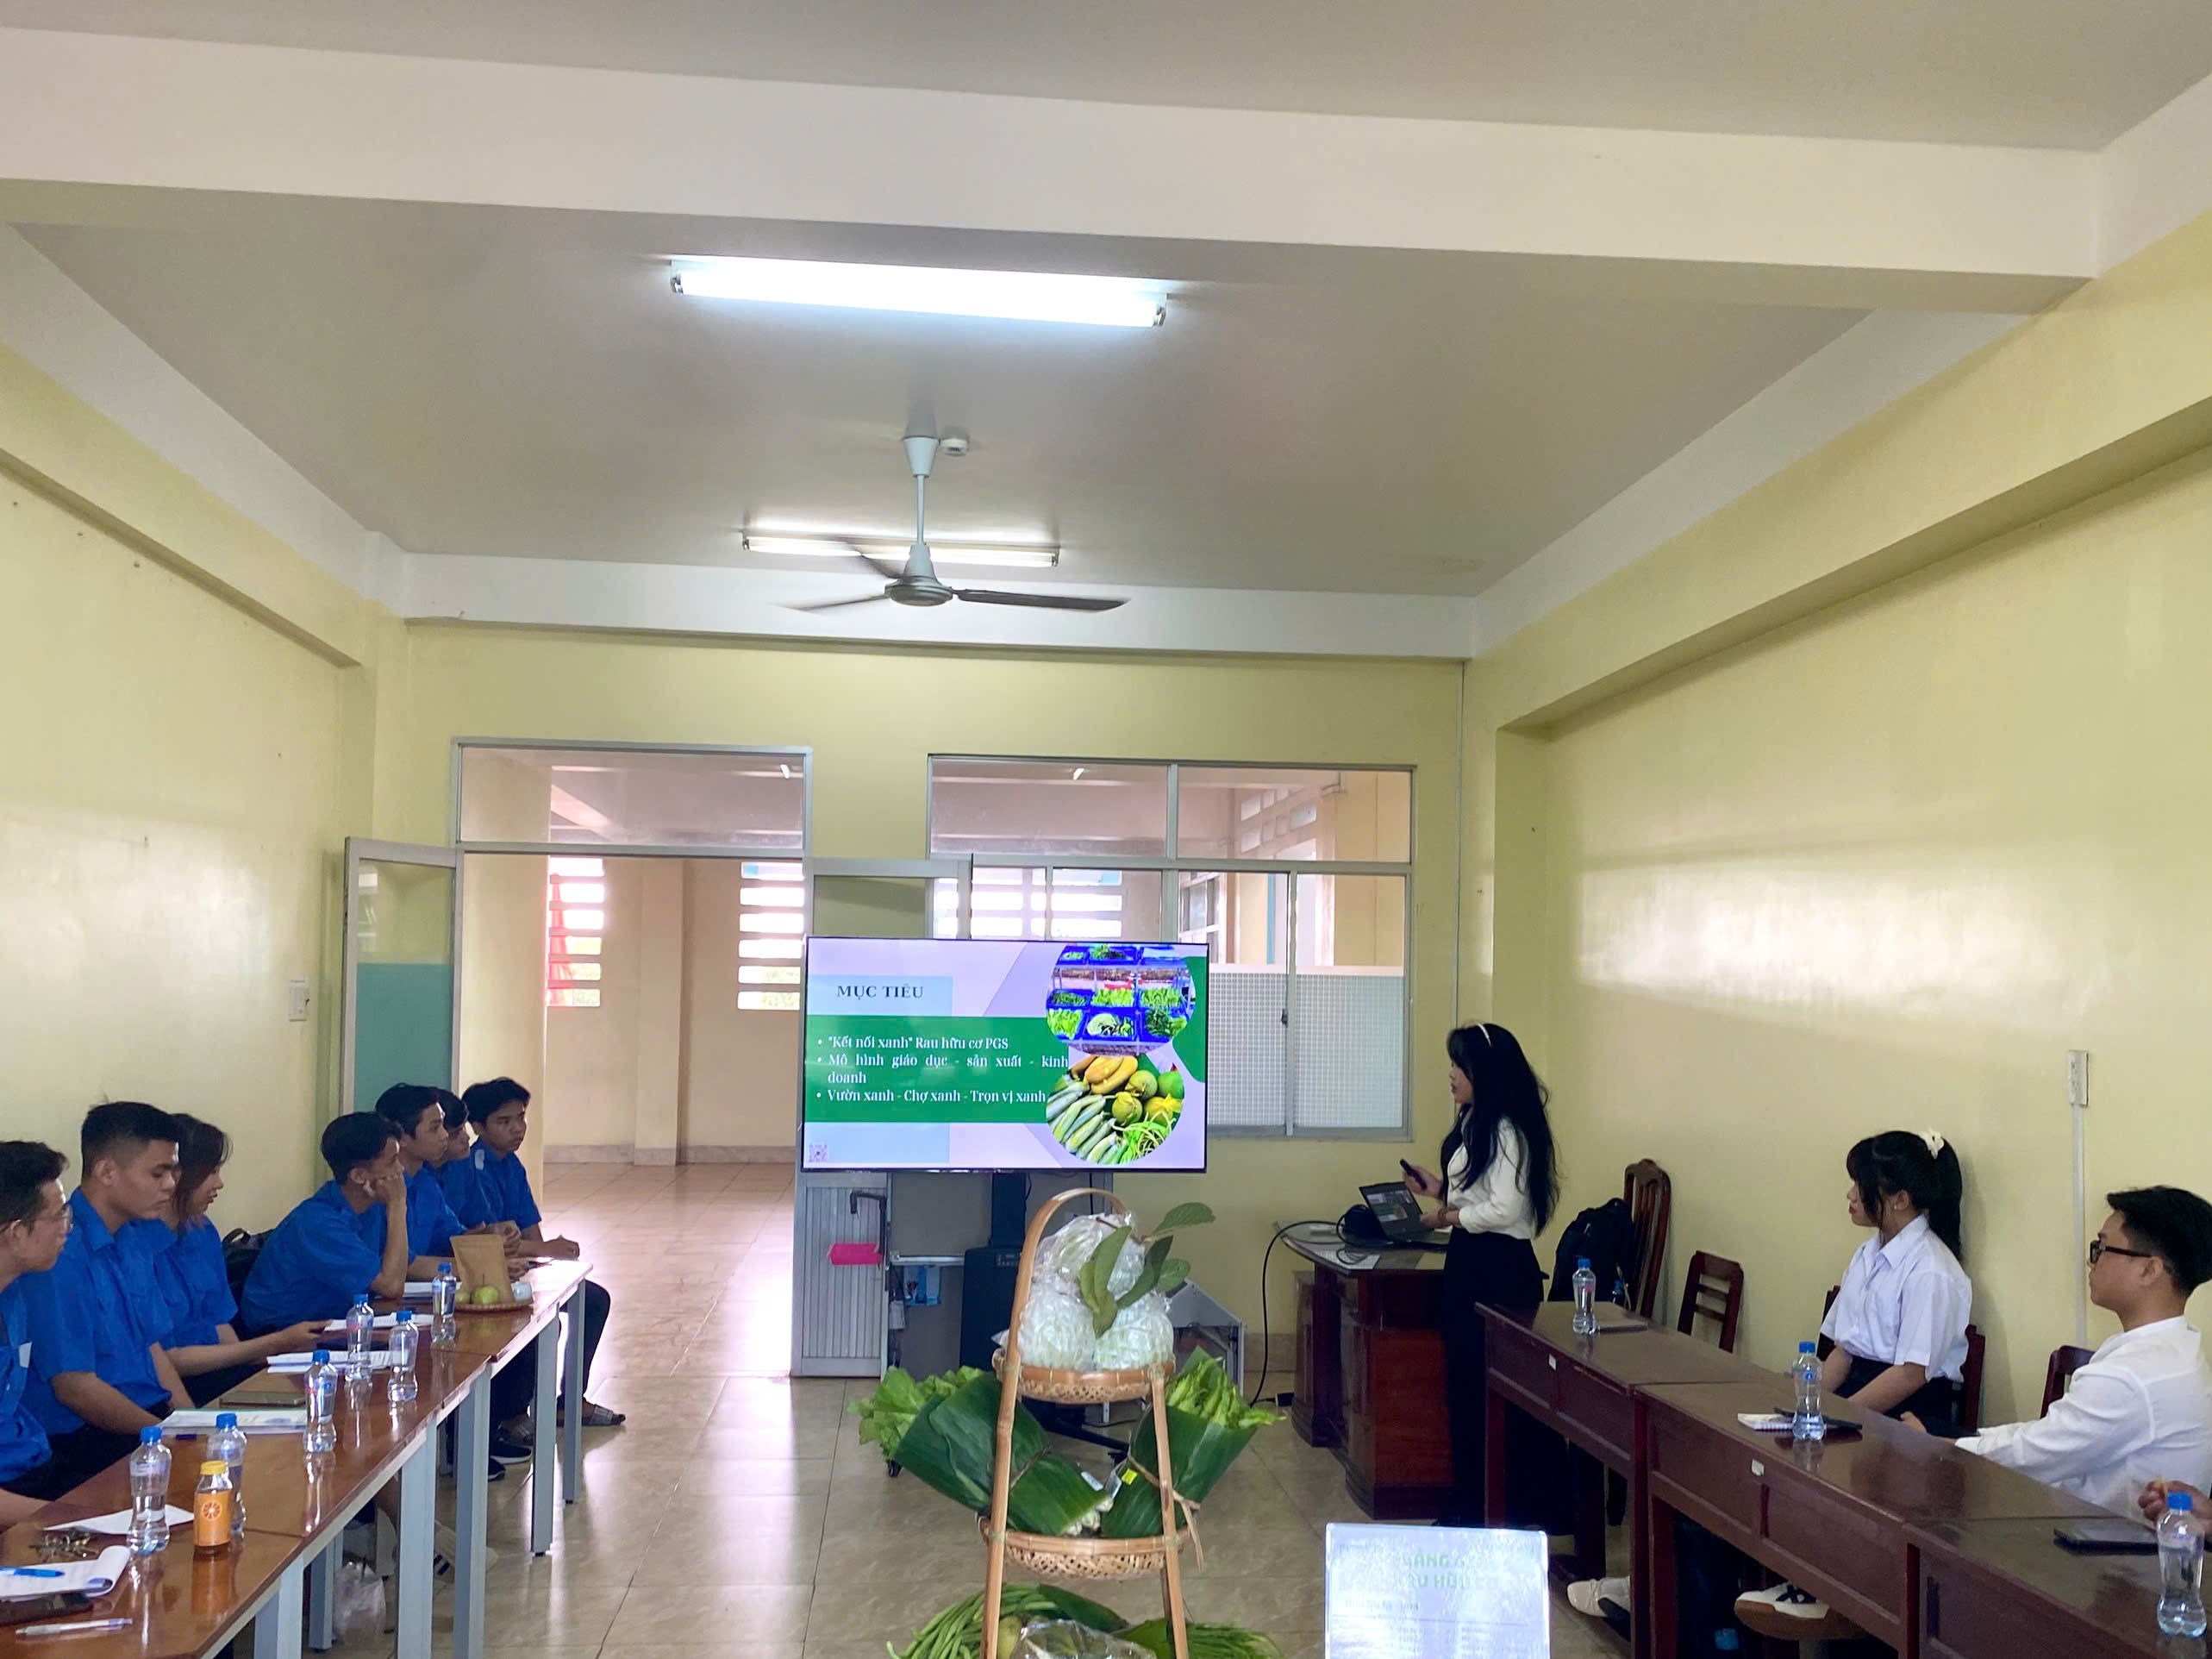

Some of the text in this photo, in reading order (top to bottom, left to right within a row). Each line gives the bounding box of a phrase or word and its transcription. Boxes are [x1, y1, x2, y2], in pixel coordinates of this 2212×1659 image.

[837, 983, 924, 1000] MỤC TIÊU
[855, 1036, 875, 1049] nối
[915, 1037, 938, 1049] Rau
[941, 1036, 965, 1049] hữu
[968, 1039, 983, 1049] cơ
[985, 1038, 1009, 1049] PGS
[828, 1054, 848, 1066] Mô
[855, 1054, 884, 1066] hình
[891, 1054, 918, 1069] giáo
[925, 1055, 948, 1068] dục
[966, 1055, 988, 1067] sản
[996, 1055, 1022, 1067] xuất
[1041, 1055, 1068, 1067] kinh
[828, 1071, 866, 1084] doanh
[828, 1089, 860, 1101] Vườn
[863, 1089, 894, 1101] xanh
[903, 1090, 928, 1104] Chợ
[930, 1090, 960, 1102] xanh
[970, 1090, 999, 1104] Trọn
[1002, 1091, 1013, 1104] vị
[1015, 1090, 1046, 1102] xanh
